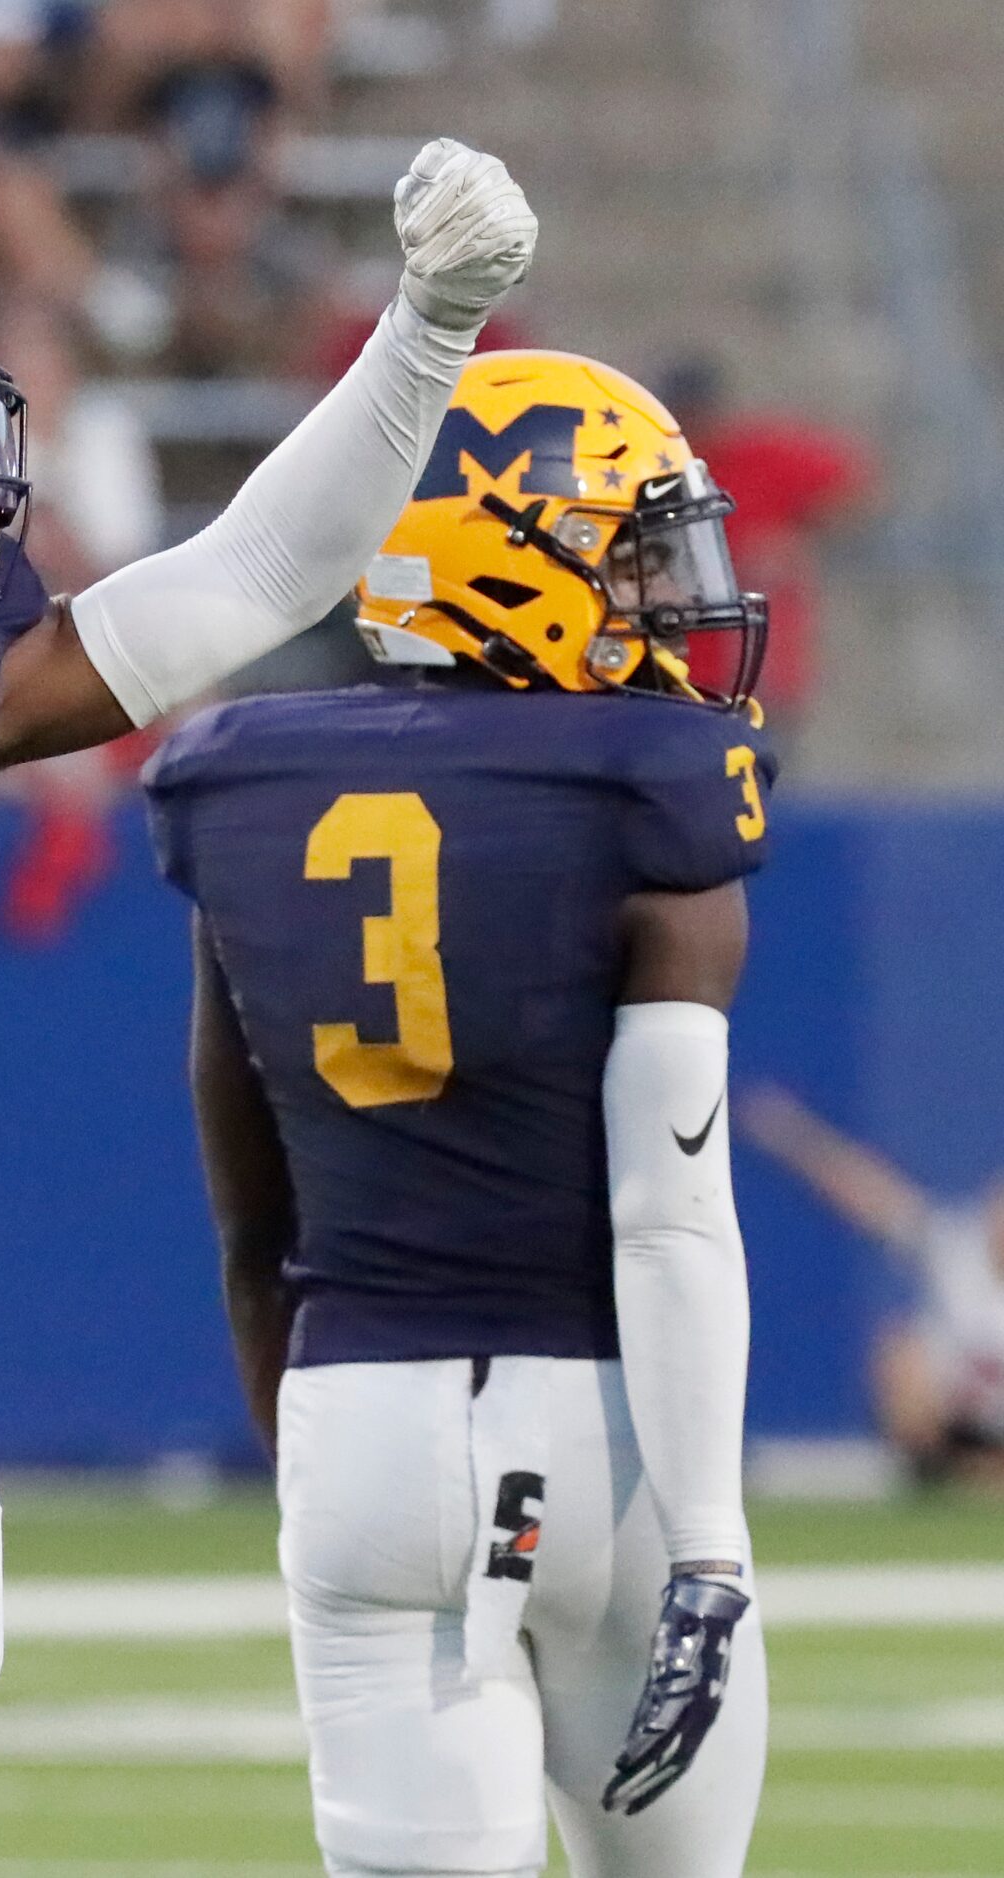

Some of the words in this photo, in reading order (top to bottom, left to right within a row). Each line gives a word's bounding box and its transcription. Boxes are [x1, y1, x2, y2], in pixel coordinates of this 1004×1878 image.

[412, 405, 585, 502] M
[725, 745, 765, 842] 3
[304, 792, 453, 1106] 3
